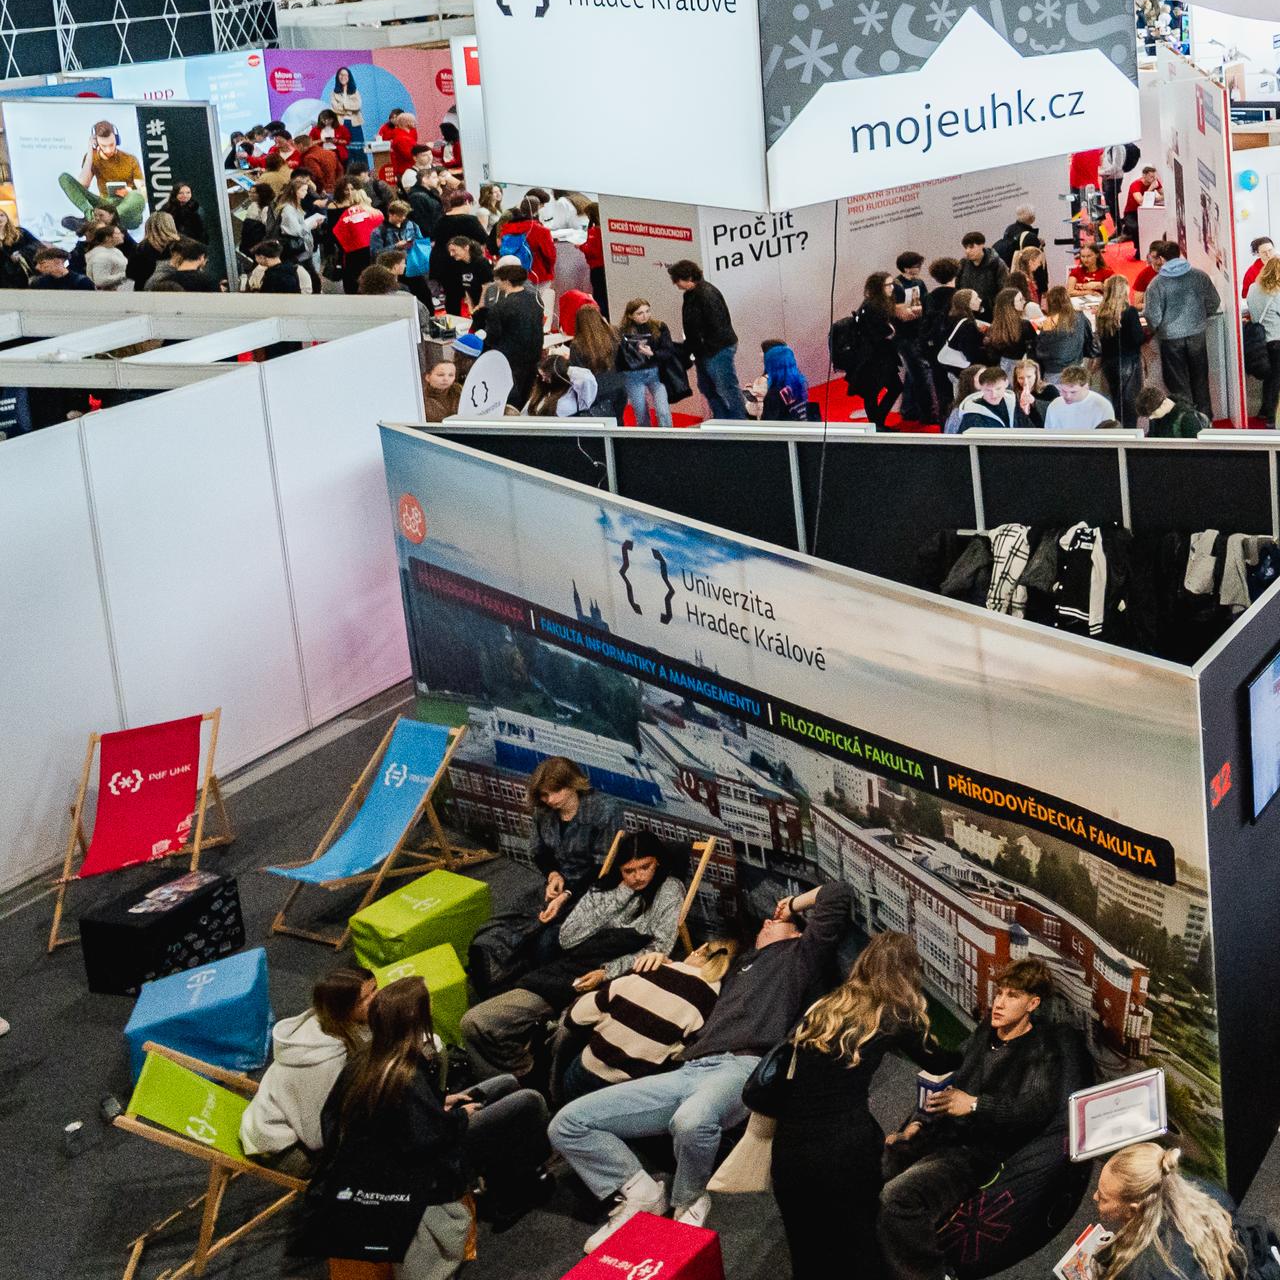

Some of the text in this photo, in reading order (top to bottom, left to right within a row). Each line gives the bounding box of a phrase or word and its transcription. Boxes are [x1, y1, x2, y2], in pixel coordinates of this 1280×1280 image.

[850, 87, 1086, 154] mojeuhk.cz
[713, 210, 794, 246] Proč jít
[848, 204, 865, 216] PRO
[715, 231, 809, 271] na VUT?
[682, 568, 775, 620] Univerzita
[686, 601, 827, 673] Hradec Králové
[540, 616, 762, 717] FAKULTA INFORMATIKY A MANAGEMENTU
[169, 764, 191, 778] UHK
[780, 711, 925, 780] FILOZOFICKÁ FAKULTA
[1210, 761, 1232, 810] 32
[948, 774, 1157, 868] PŘÍRODOVĚDECKÁ FAKULTA
